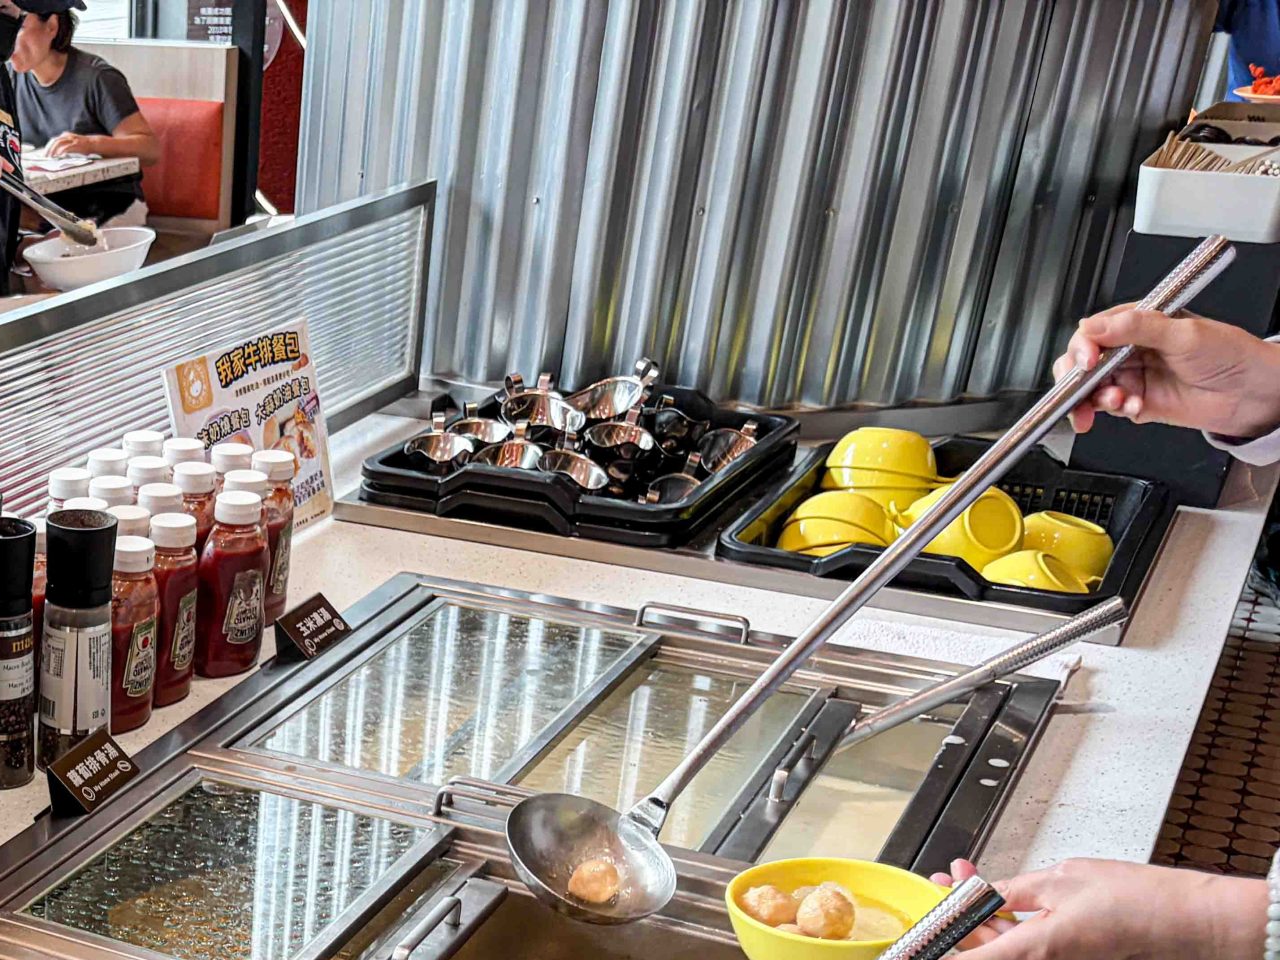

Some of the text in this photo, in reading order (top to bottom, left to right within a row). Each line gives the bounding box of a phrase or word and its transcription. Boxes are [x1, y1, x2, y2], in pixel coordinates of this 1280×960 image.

[215, 332, 301, 388] 我家牛排餐包
